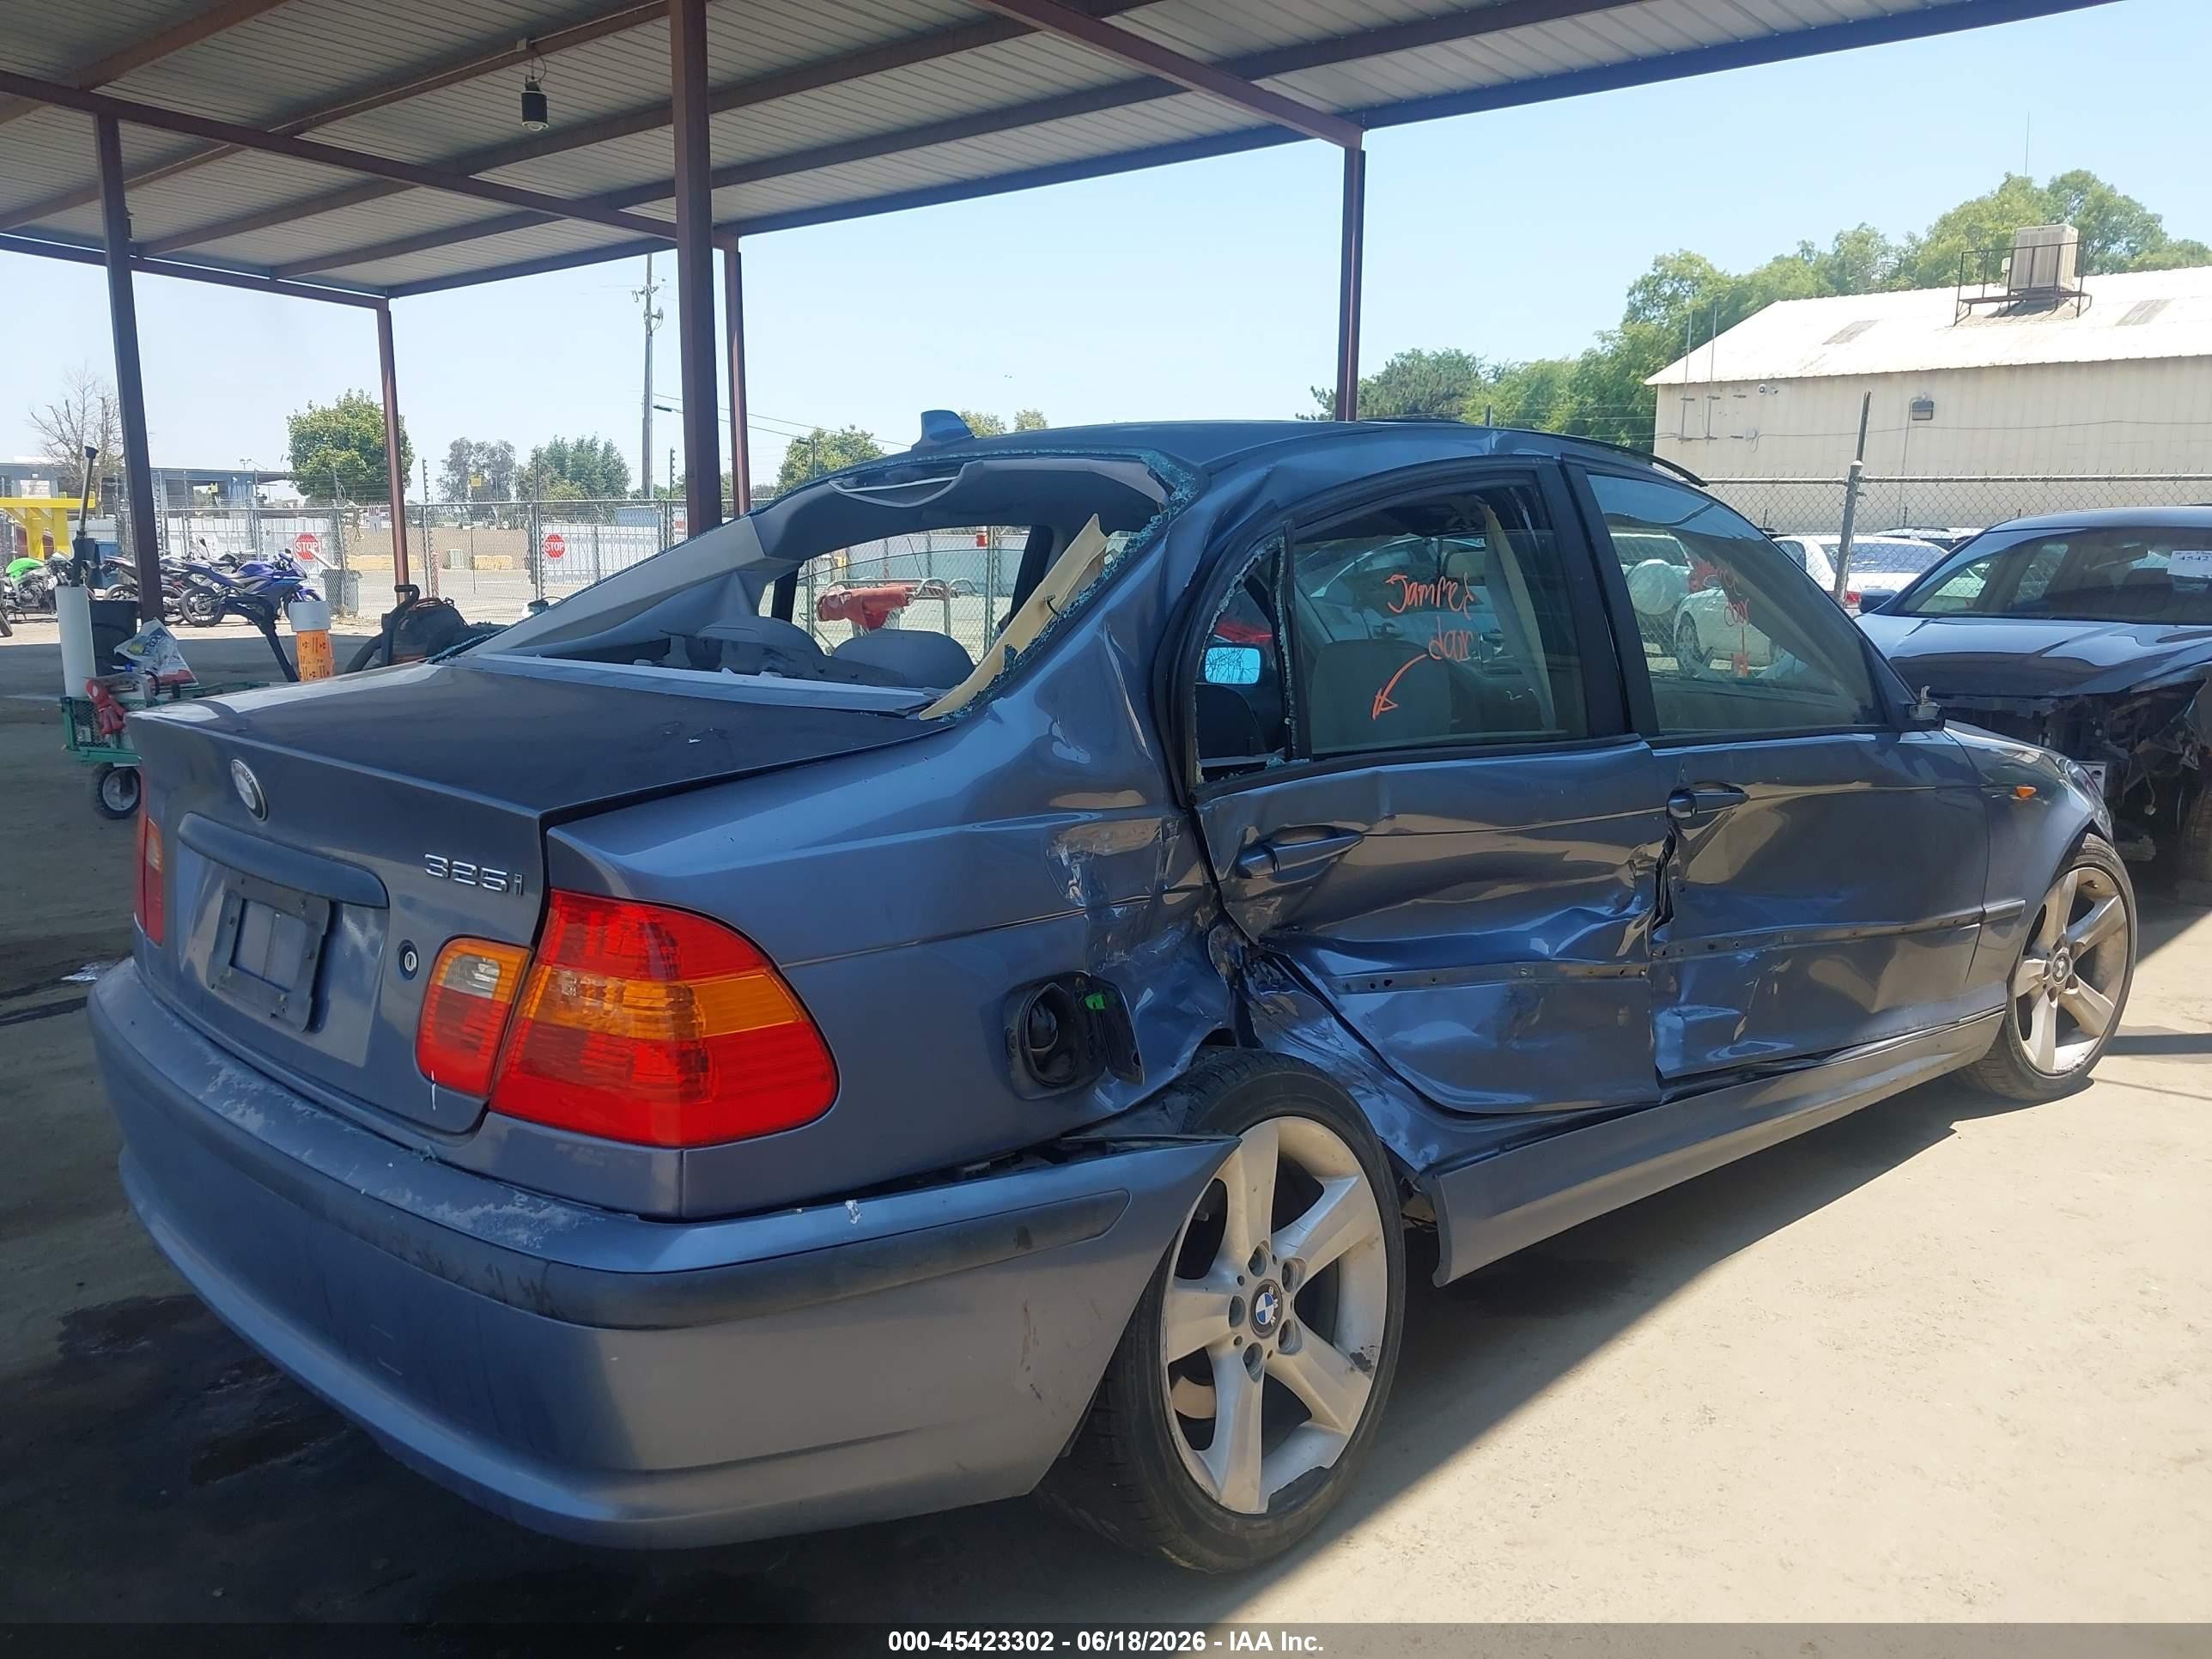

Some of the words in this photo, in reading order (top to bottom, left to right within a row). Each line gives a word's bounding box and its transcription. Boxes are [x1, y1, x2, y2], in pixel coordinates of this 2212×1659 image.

[295, 541, 319, 550] STOP
[544, 541, 564, 550] STOP
[424, 853, 523, 896] 325i
